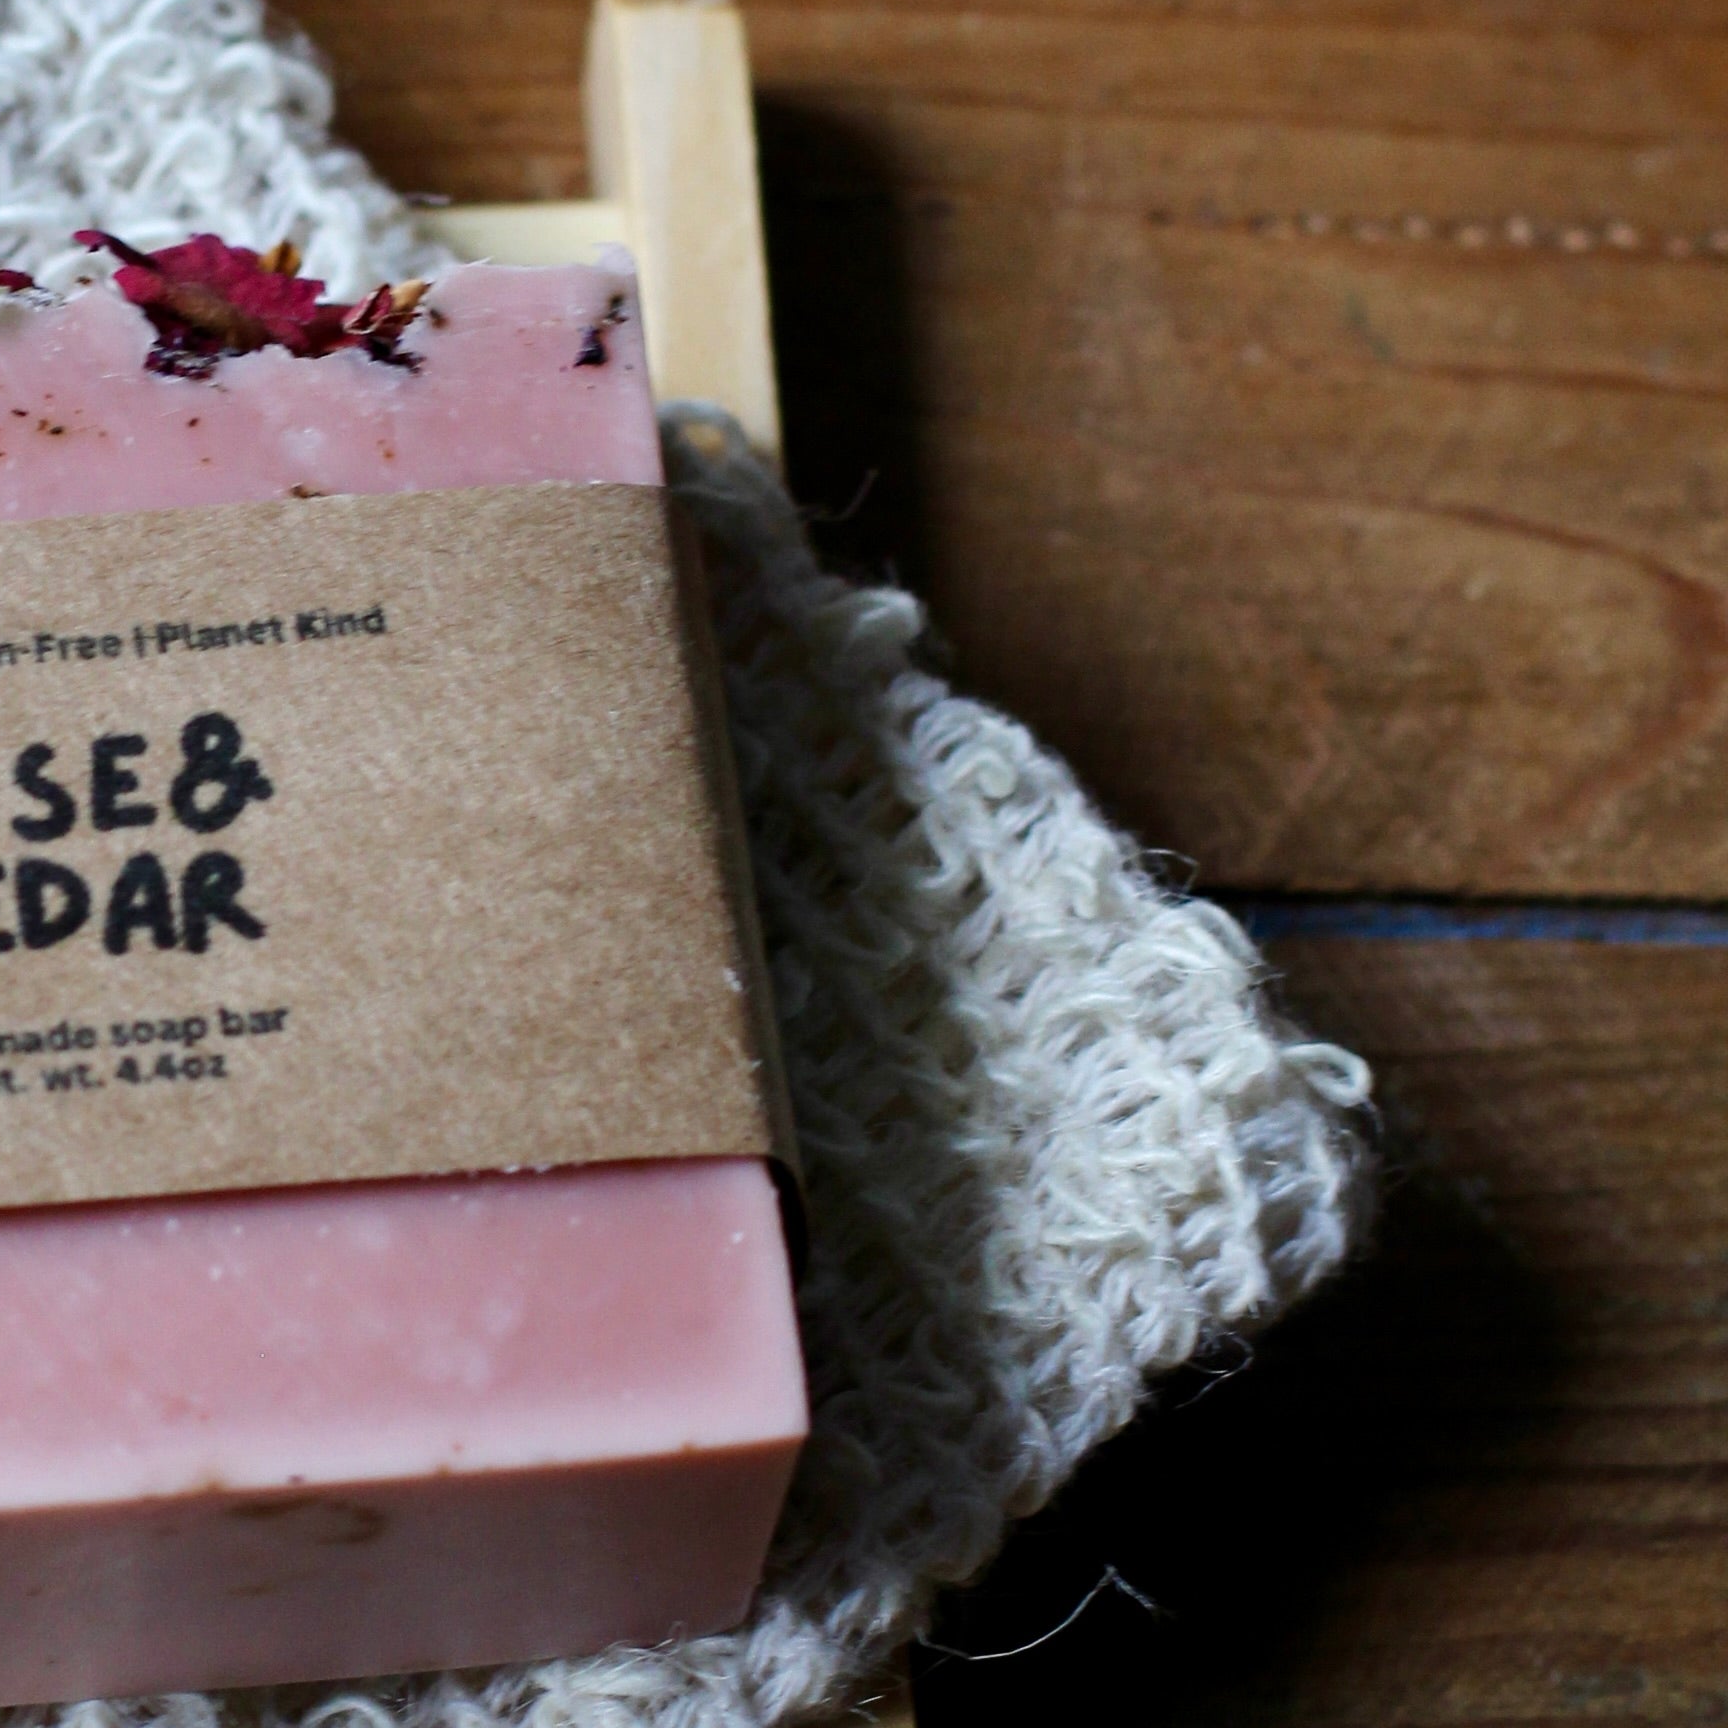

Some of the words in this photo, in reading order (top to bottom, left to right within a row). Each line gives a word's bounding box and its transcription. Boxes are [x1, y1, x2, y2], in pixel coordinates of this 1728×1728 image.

[155, 616, 286, 653] Planet
[294, 603, 387, 640] Kind
[110, 1014, 208, 1049] soap
[217, 1007, 289, 1038] bar
[43, 1062, 104, 1092] wt.
